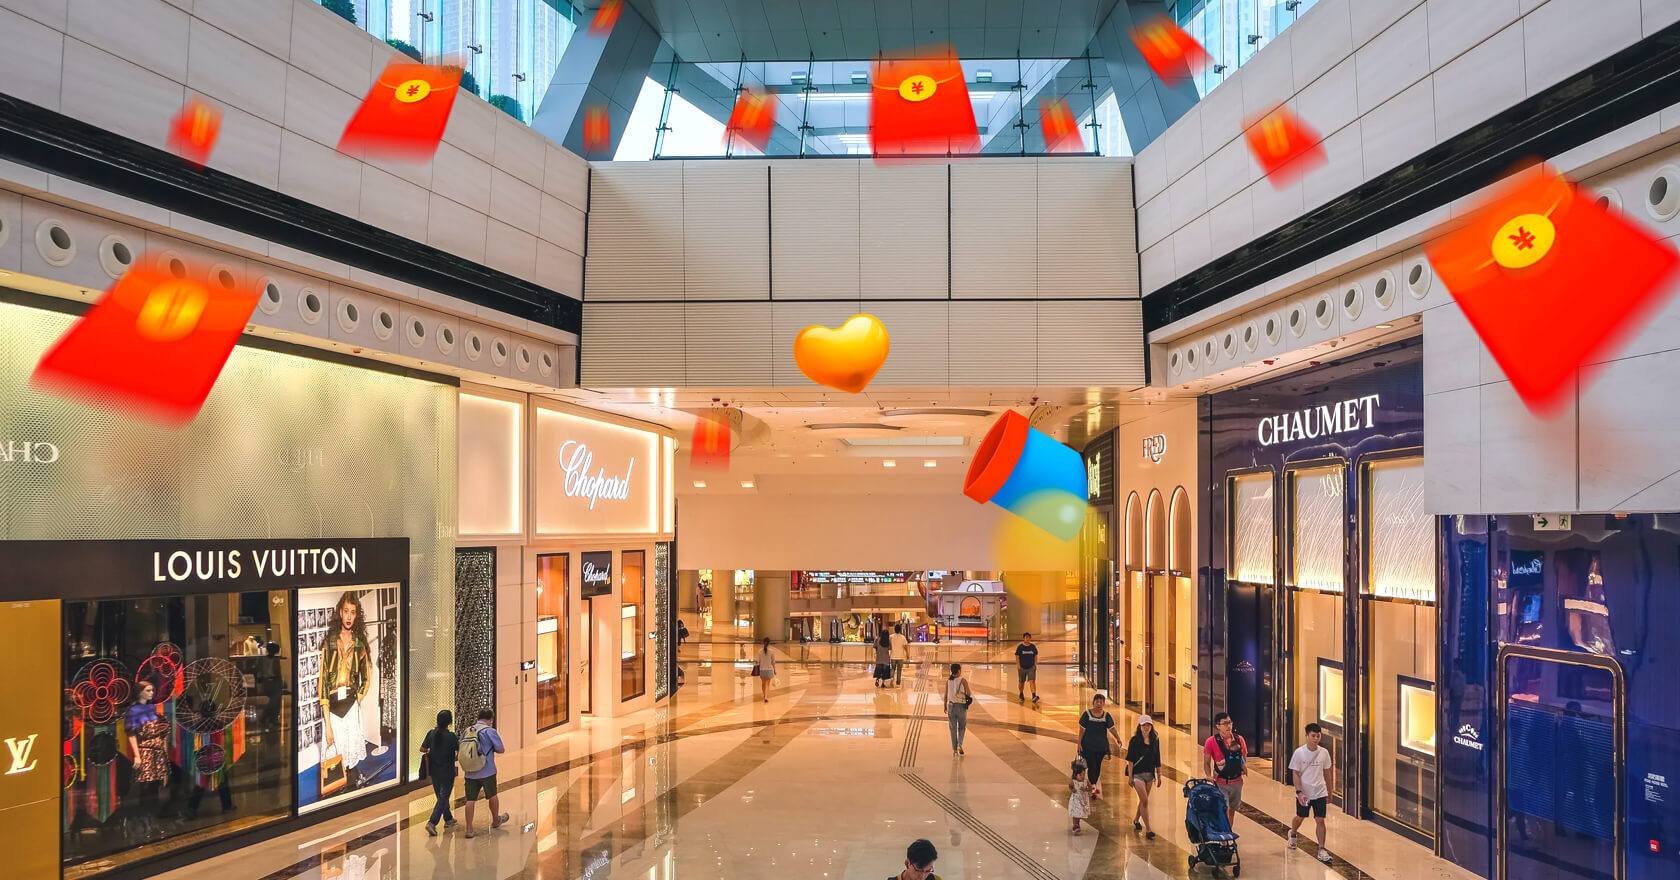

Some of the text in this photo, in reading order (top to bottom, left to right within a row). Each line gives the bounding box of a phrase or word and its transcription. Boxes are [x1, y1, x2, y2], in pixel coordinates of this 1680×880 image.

[1258, 394, 1380, 446] CHAUMET
[1142, 434, 1167, 464] FRED
[559, 440, 635, 511] Chopard
[154, 547, 357, 582] LOUIS VUITTON
[583, 561, 610, 586] Chopard
[4, 734, 38, 775] LV
[1453, 735, 1484, 751] CHAUMET
